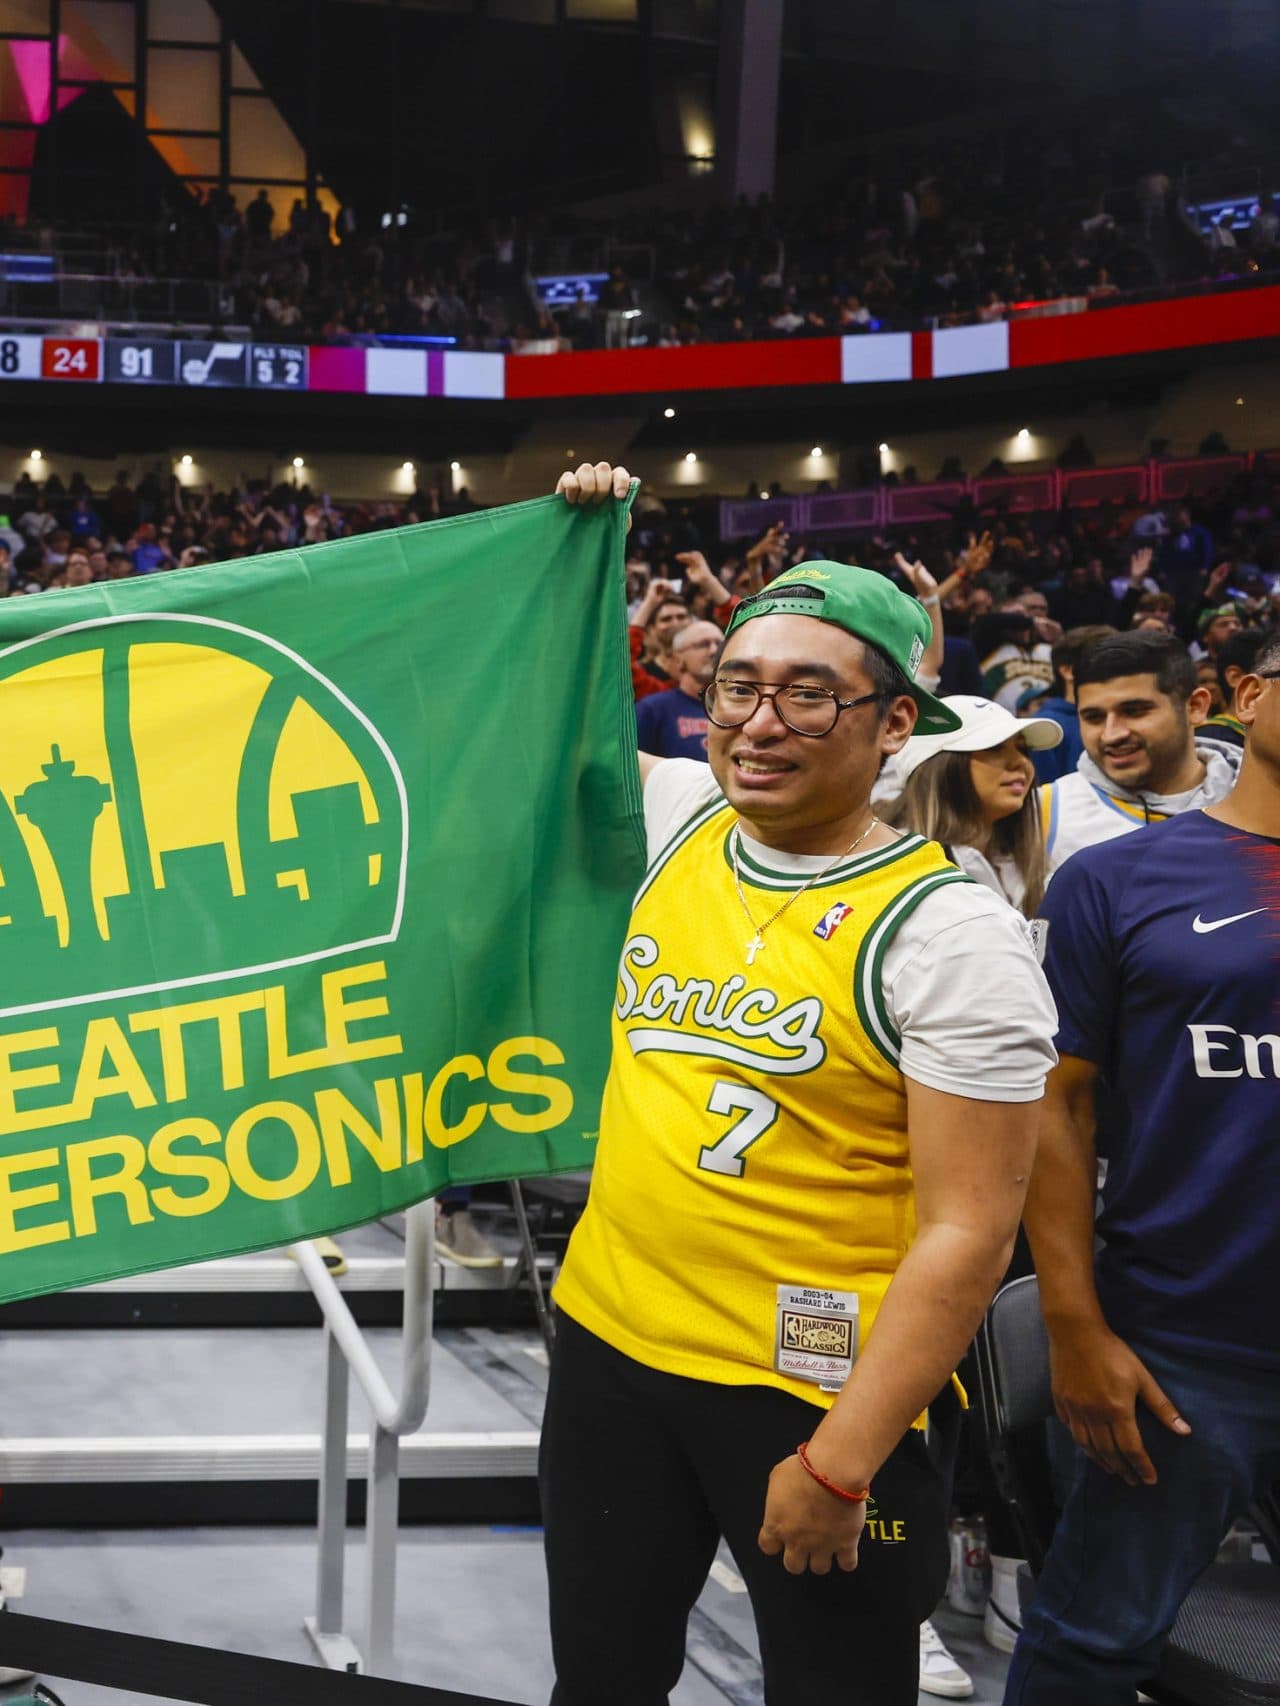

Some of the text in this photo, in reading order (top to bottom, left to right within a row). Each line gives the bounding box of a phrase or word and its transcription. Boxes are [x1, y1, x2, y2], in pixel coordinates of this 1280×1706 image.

[53, 347, 87, 373] 24
[121, 347, 152, 377] 91
[258, 360, 300, 384] 5 2
[616, 934, 827, 1062] Sonics
[697, 1080, 780, 1179] 7
[790, 1296, 846, 1311] RASHARD LEWIS
[802, 1289, 834, 1300] 2003-04
[801, 1318, 846, 1339] HARDWOOD
[800, 1335, 846, 1354] CLASSICS
